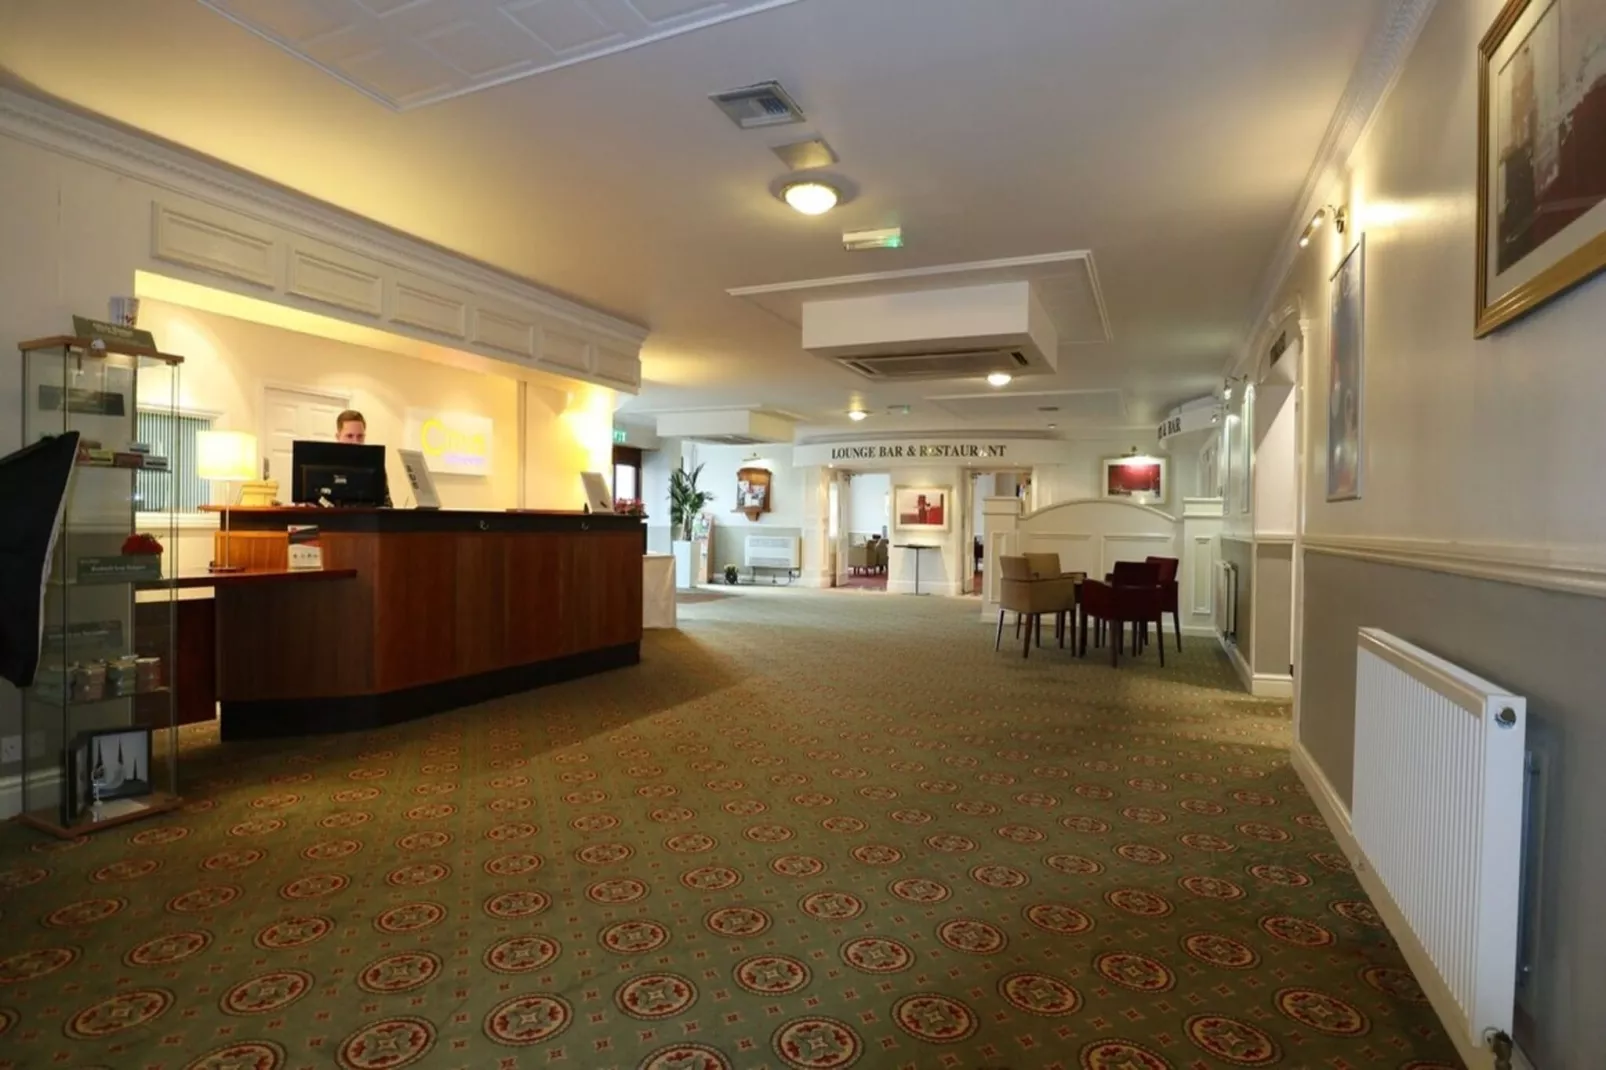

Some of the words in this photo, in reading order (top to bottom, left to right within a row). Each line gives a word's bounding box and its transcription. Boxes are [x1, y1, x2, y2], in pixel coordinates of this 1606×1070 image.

[1168, 417, 1181, 434] BAR
[831, 446, 876, 460] LOUNGE
[879, 445, 903, 458] BAR
[906, 444, 916, 457] &
